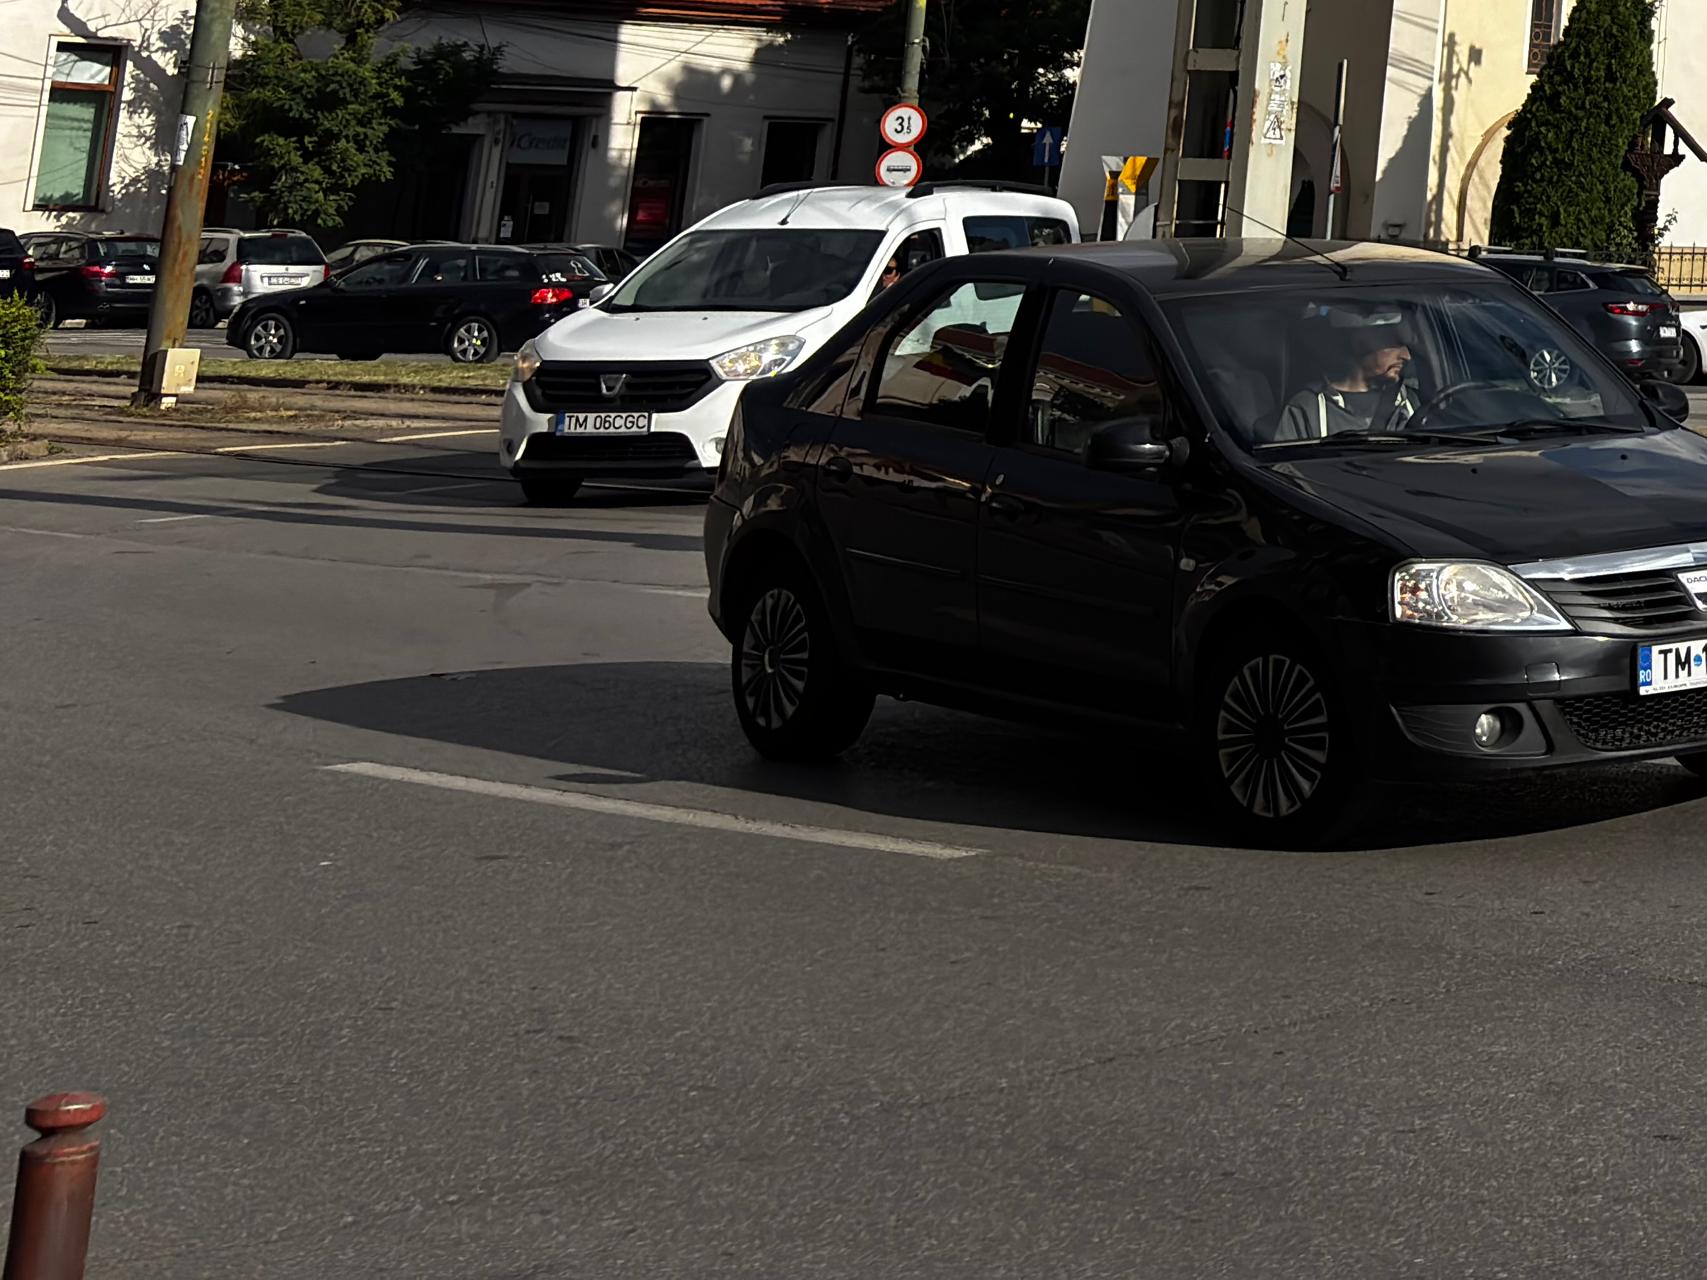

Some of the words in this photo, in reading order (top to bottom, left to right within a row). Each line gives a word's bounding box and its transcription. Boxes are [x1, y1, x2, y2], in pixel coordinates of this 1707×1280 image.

[566, 415, 588, 430] TM
[593, 414, 647, 430] 06CGC
[1640, 669, 1652, 682] RO
[1658, 646, 1692, 680] TM
